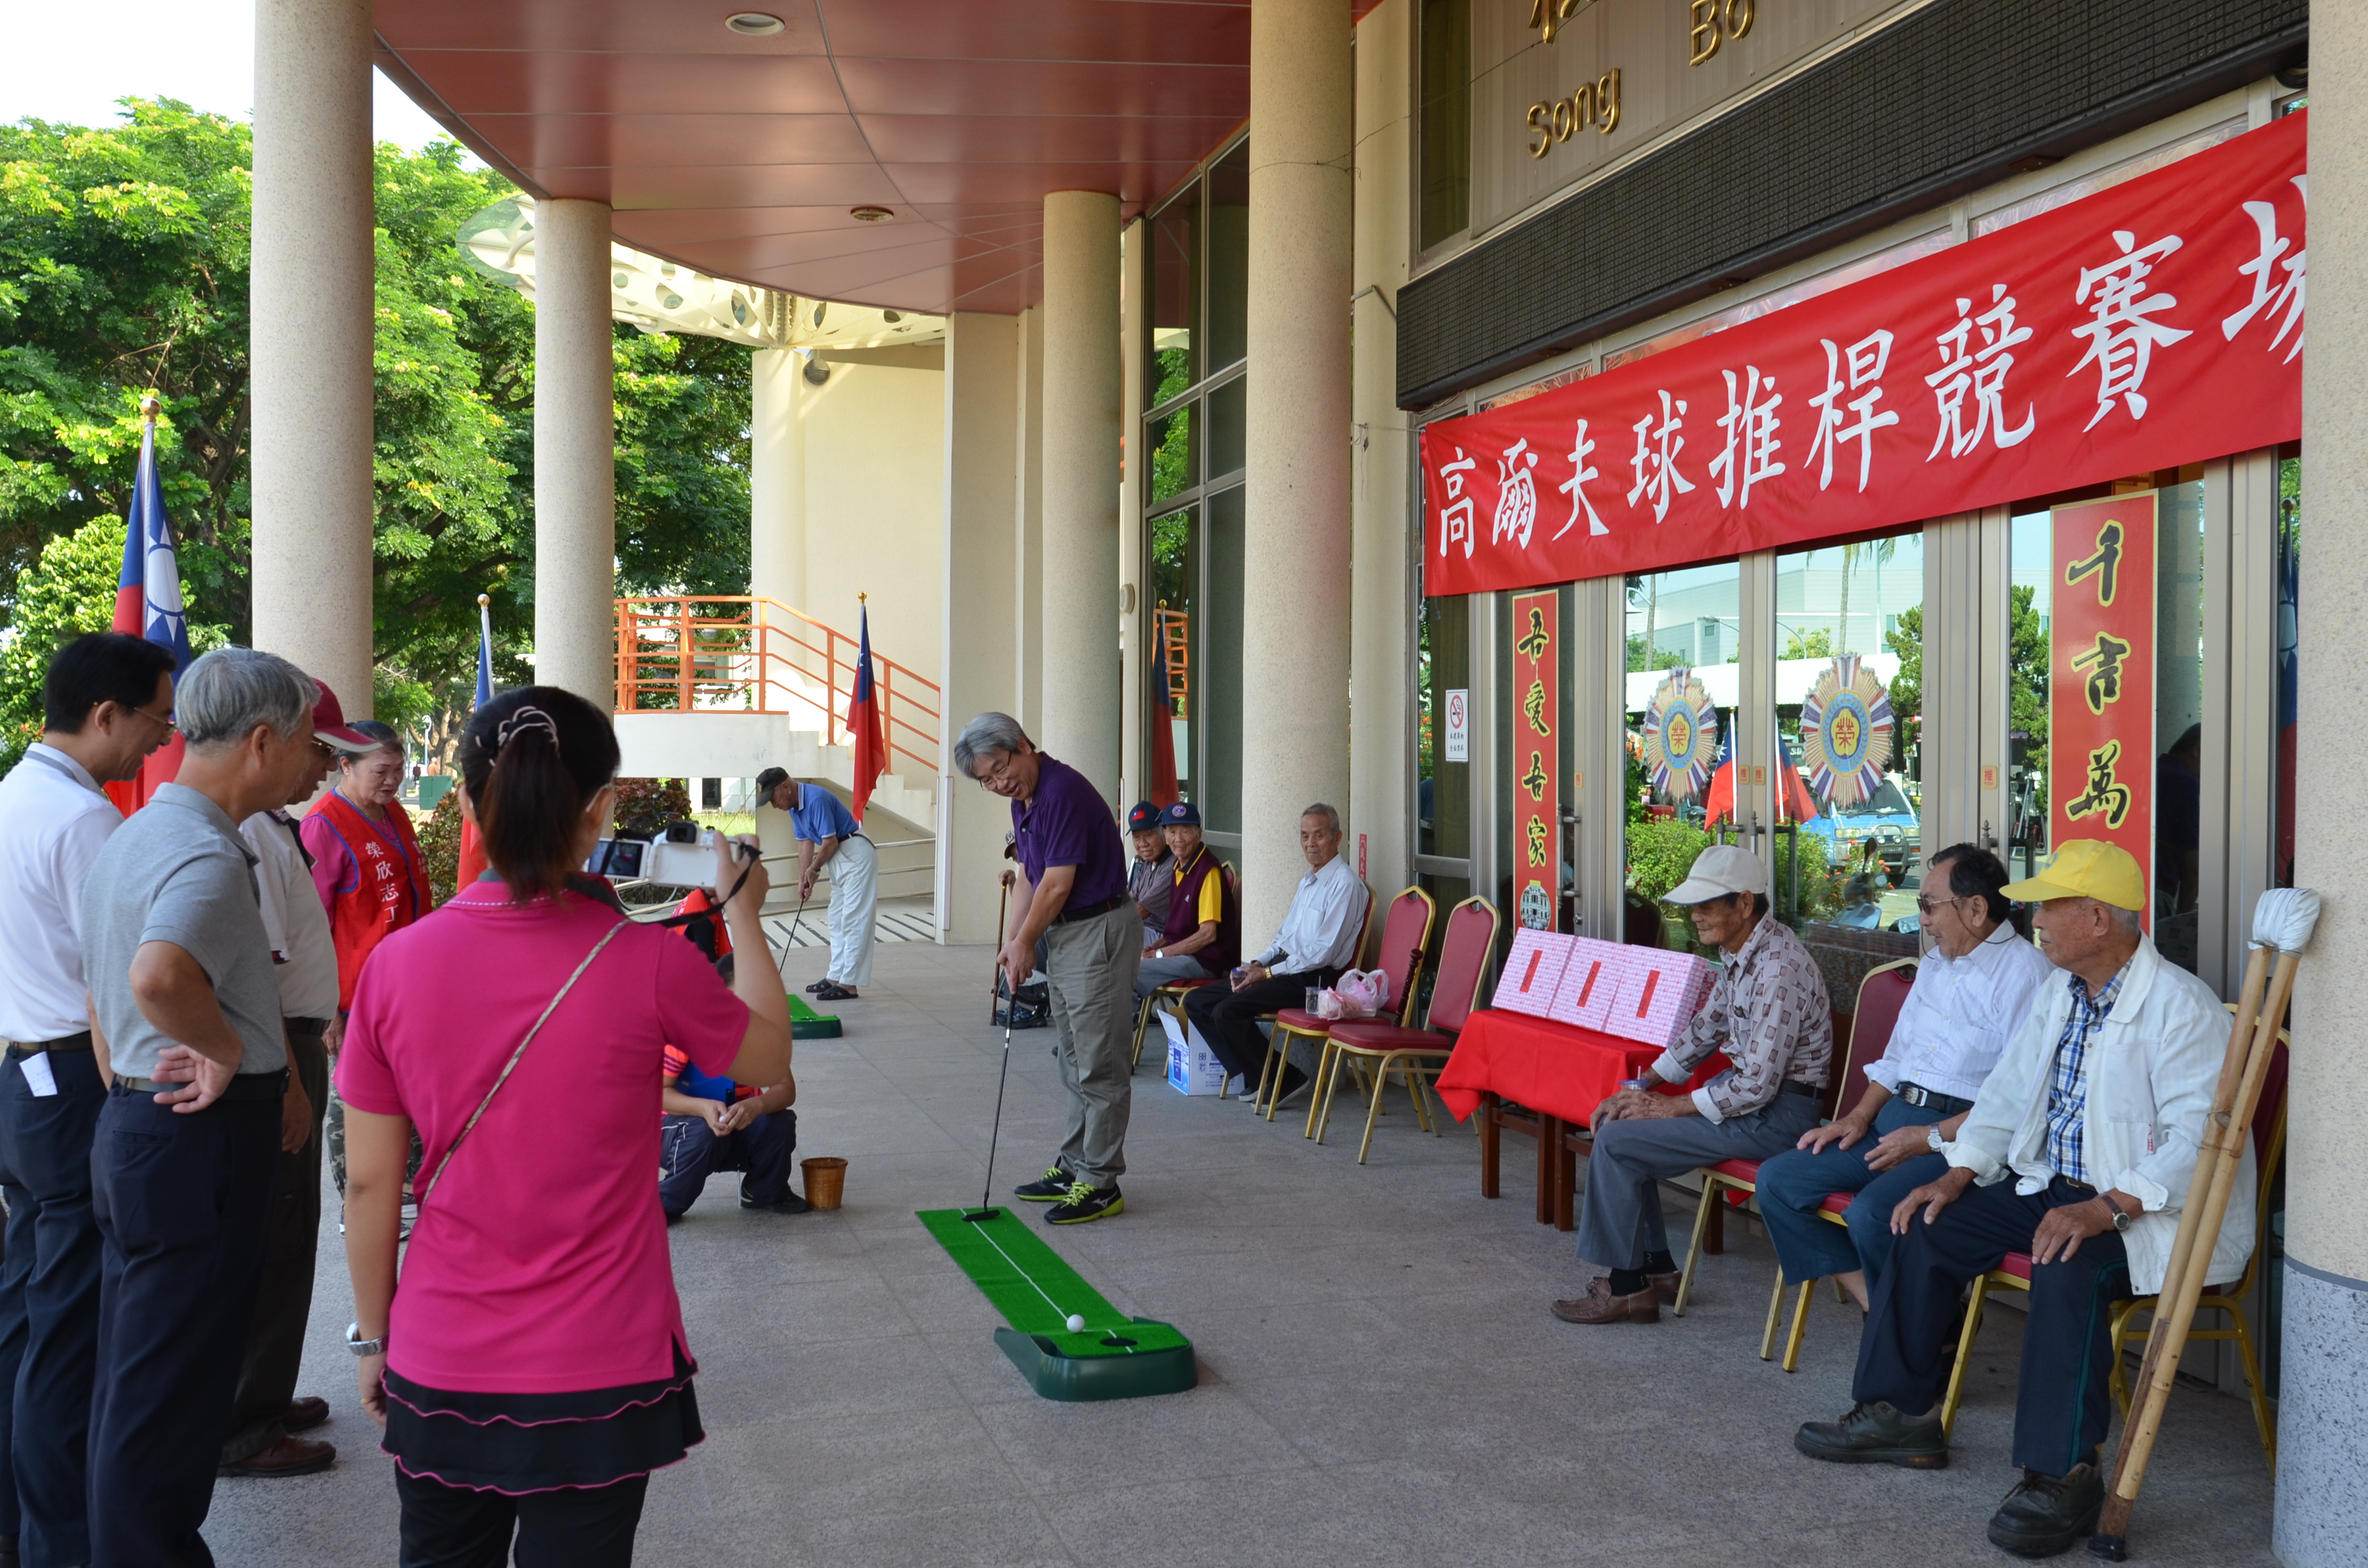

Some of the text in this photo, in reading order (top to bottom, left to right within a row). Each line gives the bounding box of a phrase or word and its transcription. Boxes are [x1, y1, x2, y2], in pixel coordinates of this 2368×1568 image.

[1526, 67, 1622, 160] Song
[1688, 0, 1756, 67] Bo
[1516, 606, 1552, 869] 吾愛吾家
[1671, 720, 1687, 749] 榮
[1835, 717, 1855, 749] 榮
[1984, 769, 1993, 781] 推
